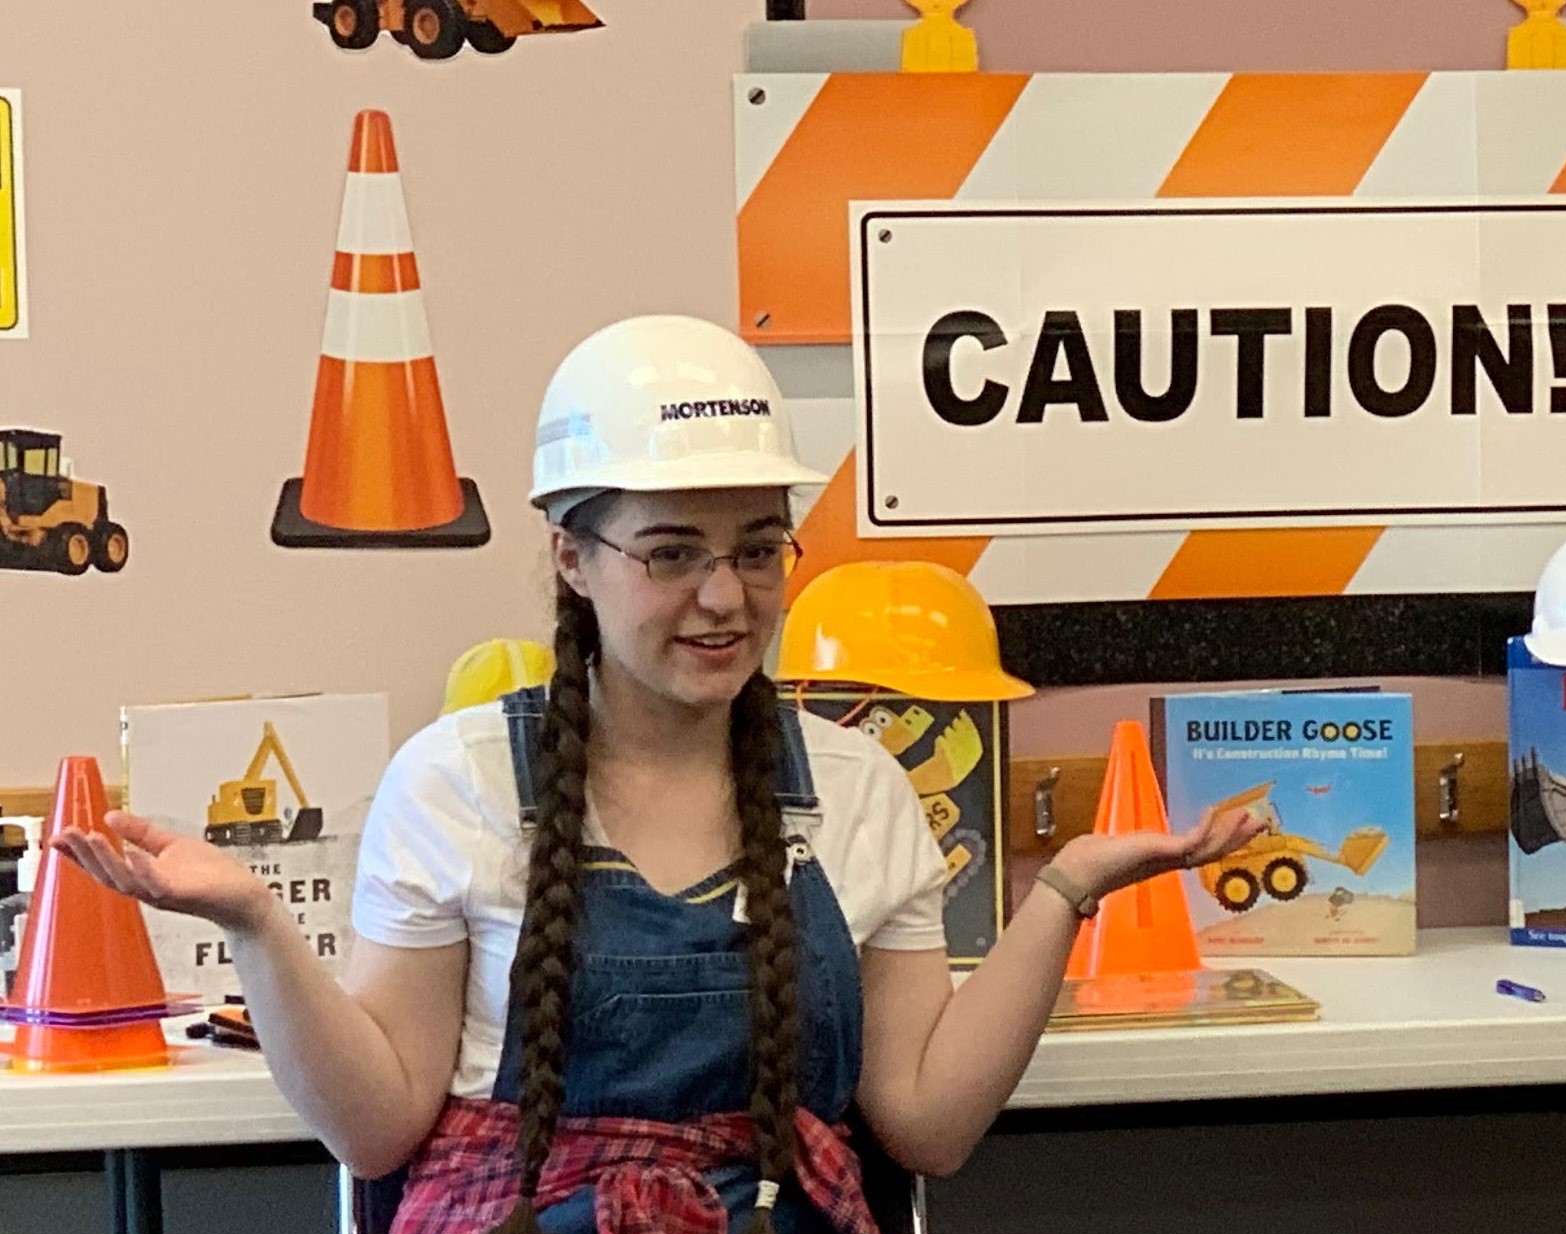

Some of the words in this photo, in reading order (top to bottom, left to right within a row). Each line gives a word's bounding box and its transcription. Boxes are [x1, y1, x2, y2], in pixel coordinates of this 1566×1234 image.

[660, 399, 770, 421] MORTENSON
[1187, 720, 1293, 742] BUILDER
[1302, 719, 1393, 742] GOOSE
[1216, 747, 1300, 760] Construction
[249, 864, 281, 875] THE
